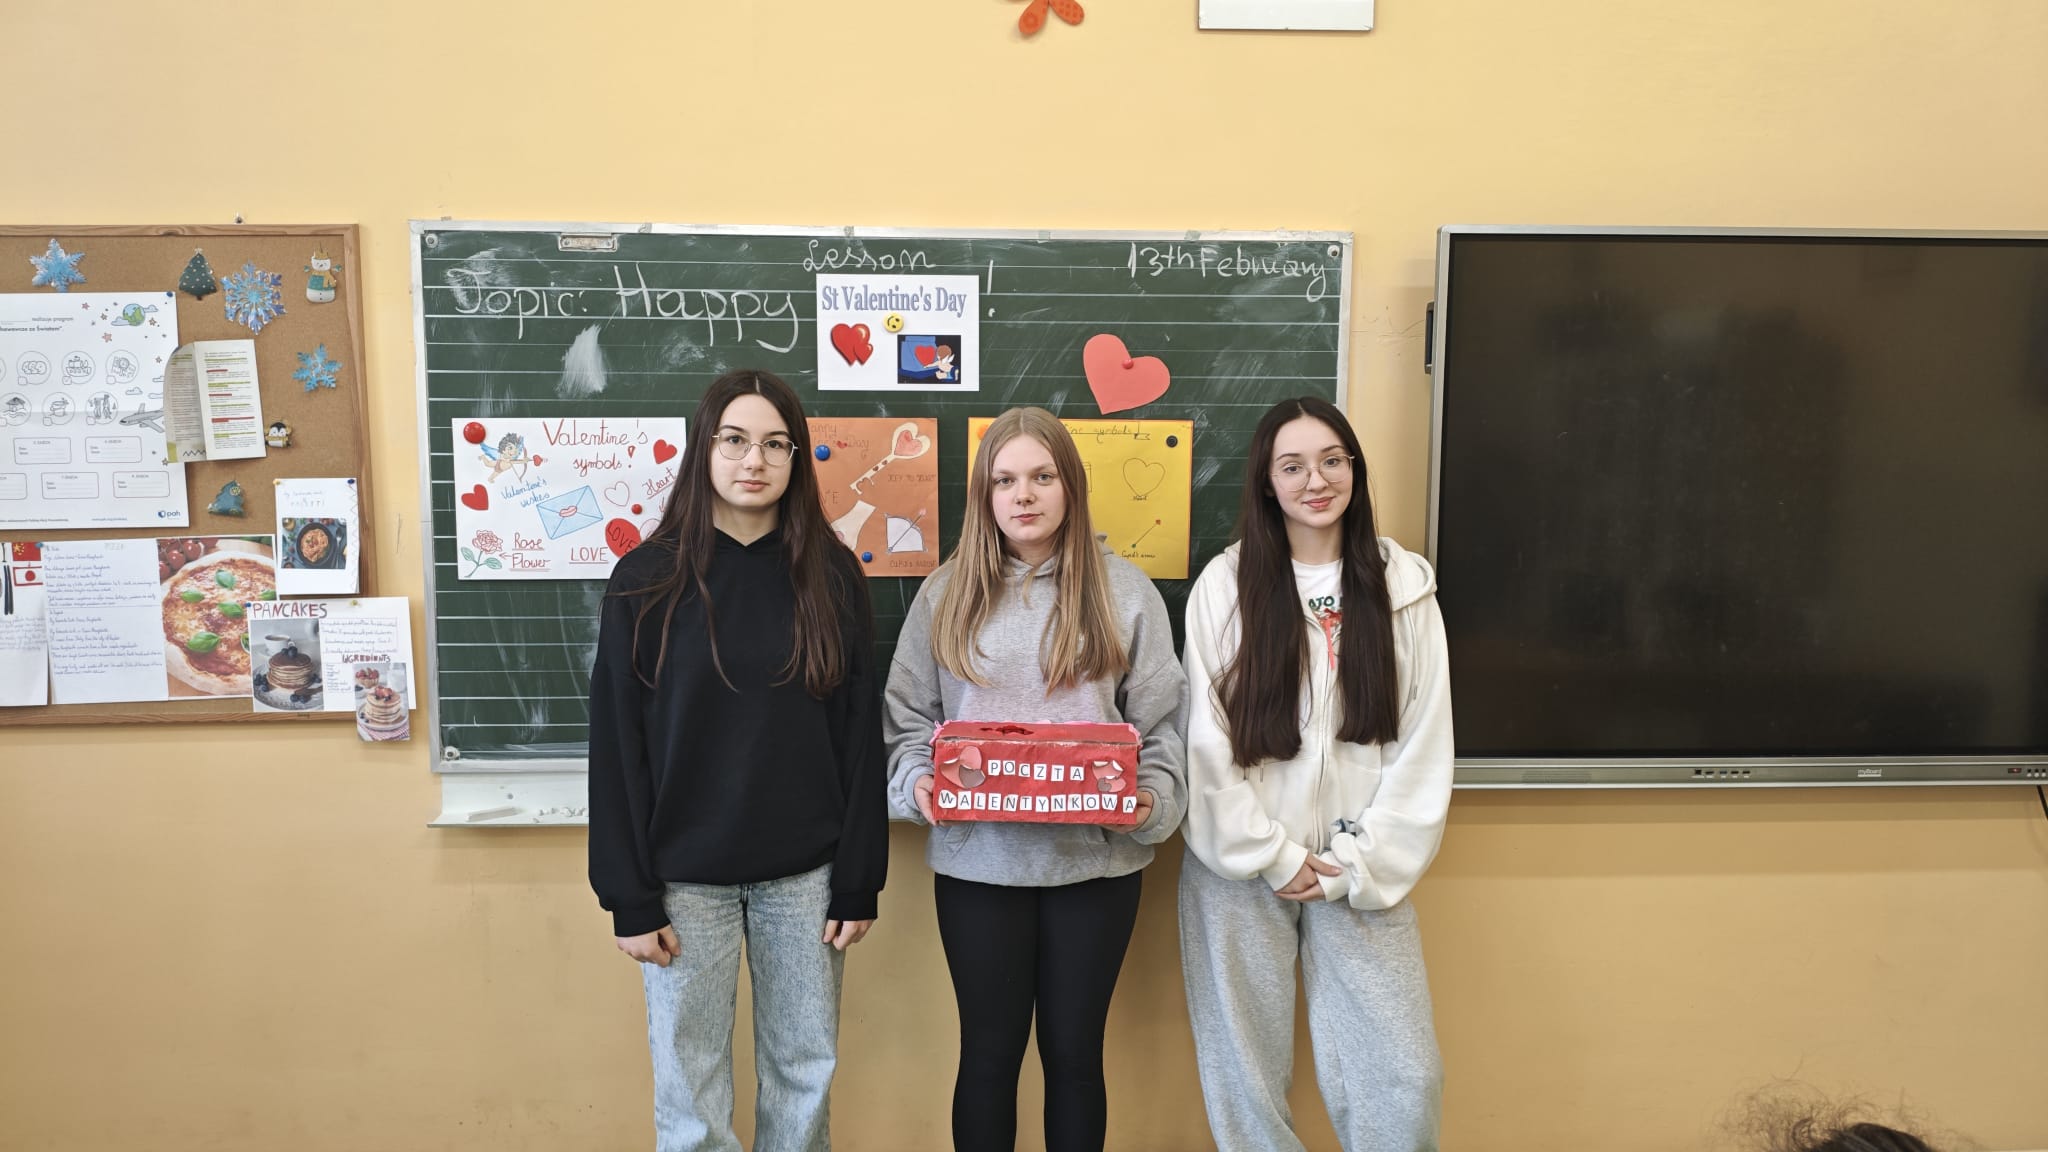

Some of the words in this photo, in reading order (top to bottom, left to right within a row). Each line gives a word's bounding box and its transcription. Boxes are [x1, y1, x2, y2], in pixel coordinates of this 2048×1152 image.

[803, 239, 936, 272] Lesson
[1127, 241, 1194, 279] 13th
[446, 267, 587, 340] Topic:
[614, 261, 799, 354] Happy
[822, 285, 839, 311] St
[842, 284, 932, 312] Valentine's
[935, 287, 967, 318] Day
[542, 419, 649, 446] Valentine's
[642, 466, 677, 497] Heart
[167, 510, 181, 519] pah
[514, 532, 543, 549] Rose
[512, 553, 551, 568] Flower
[571, 546, 608, 561] LOVE
[253, 602, 328, 618] PANCAKES
[989, 760, 1084, 780] POCZTA
[939, 791, 1136, 812] WALENTYNKOWA
